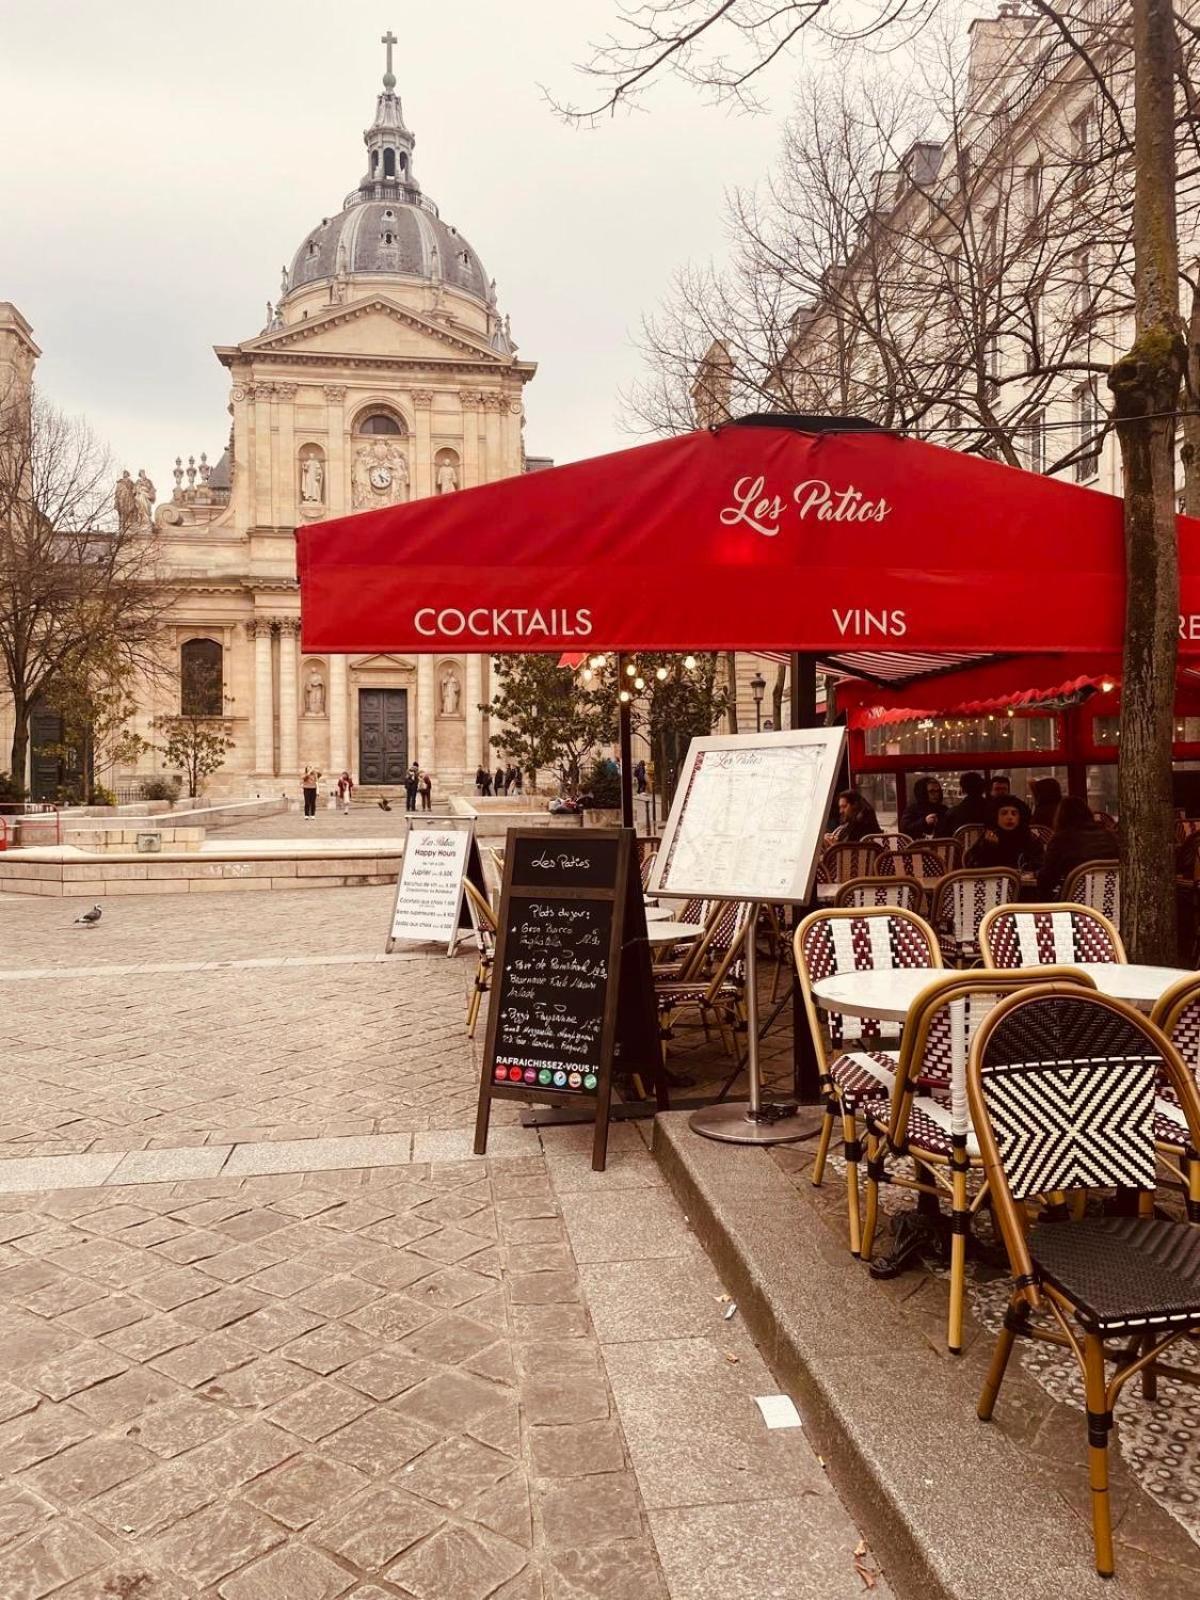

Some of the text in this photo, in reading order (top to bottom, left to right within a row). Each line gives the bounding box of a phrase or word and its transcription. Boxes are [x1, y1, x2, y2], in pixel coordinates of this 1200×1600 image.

[720, 476, 892, 537] Les Patios
[413, 608, 593, 637] COCKTAILS
[832, 609, 907, 636] VINS
[414, 849, 457, 858] Happy Hours
[531, 849, 591, 870] Les Patios
[529, 904, 555, 918] Plats
[496, 1056, 590, 1072] RAFRAICHISSEZ-VOUS
